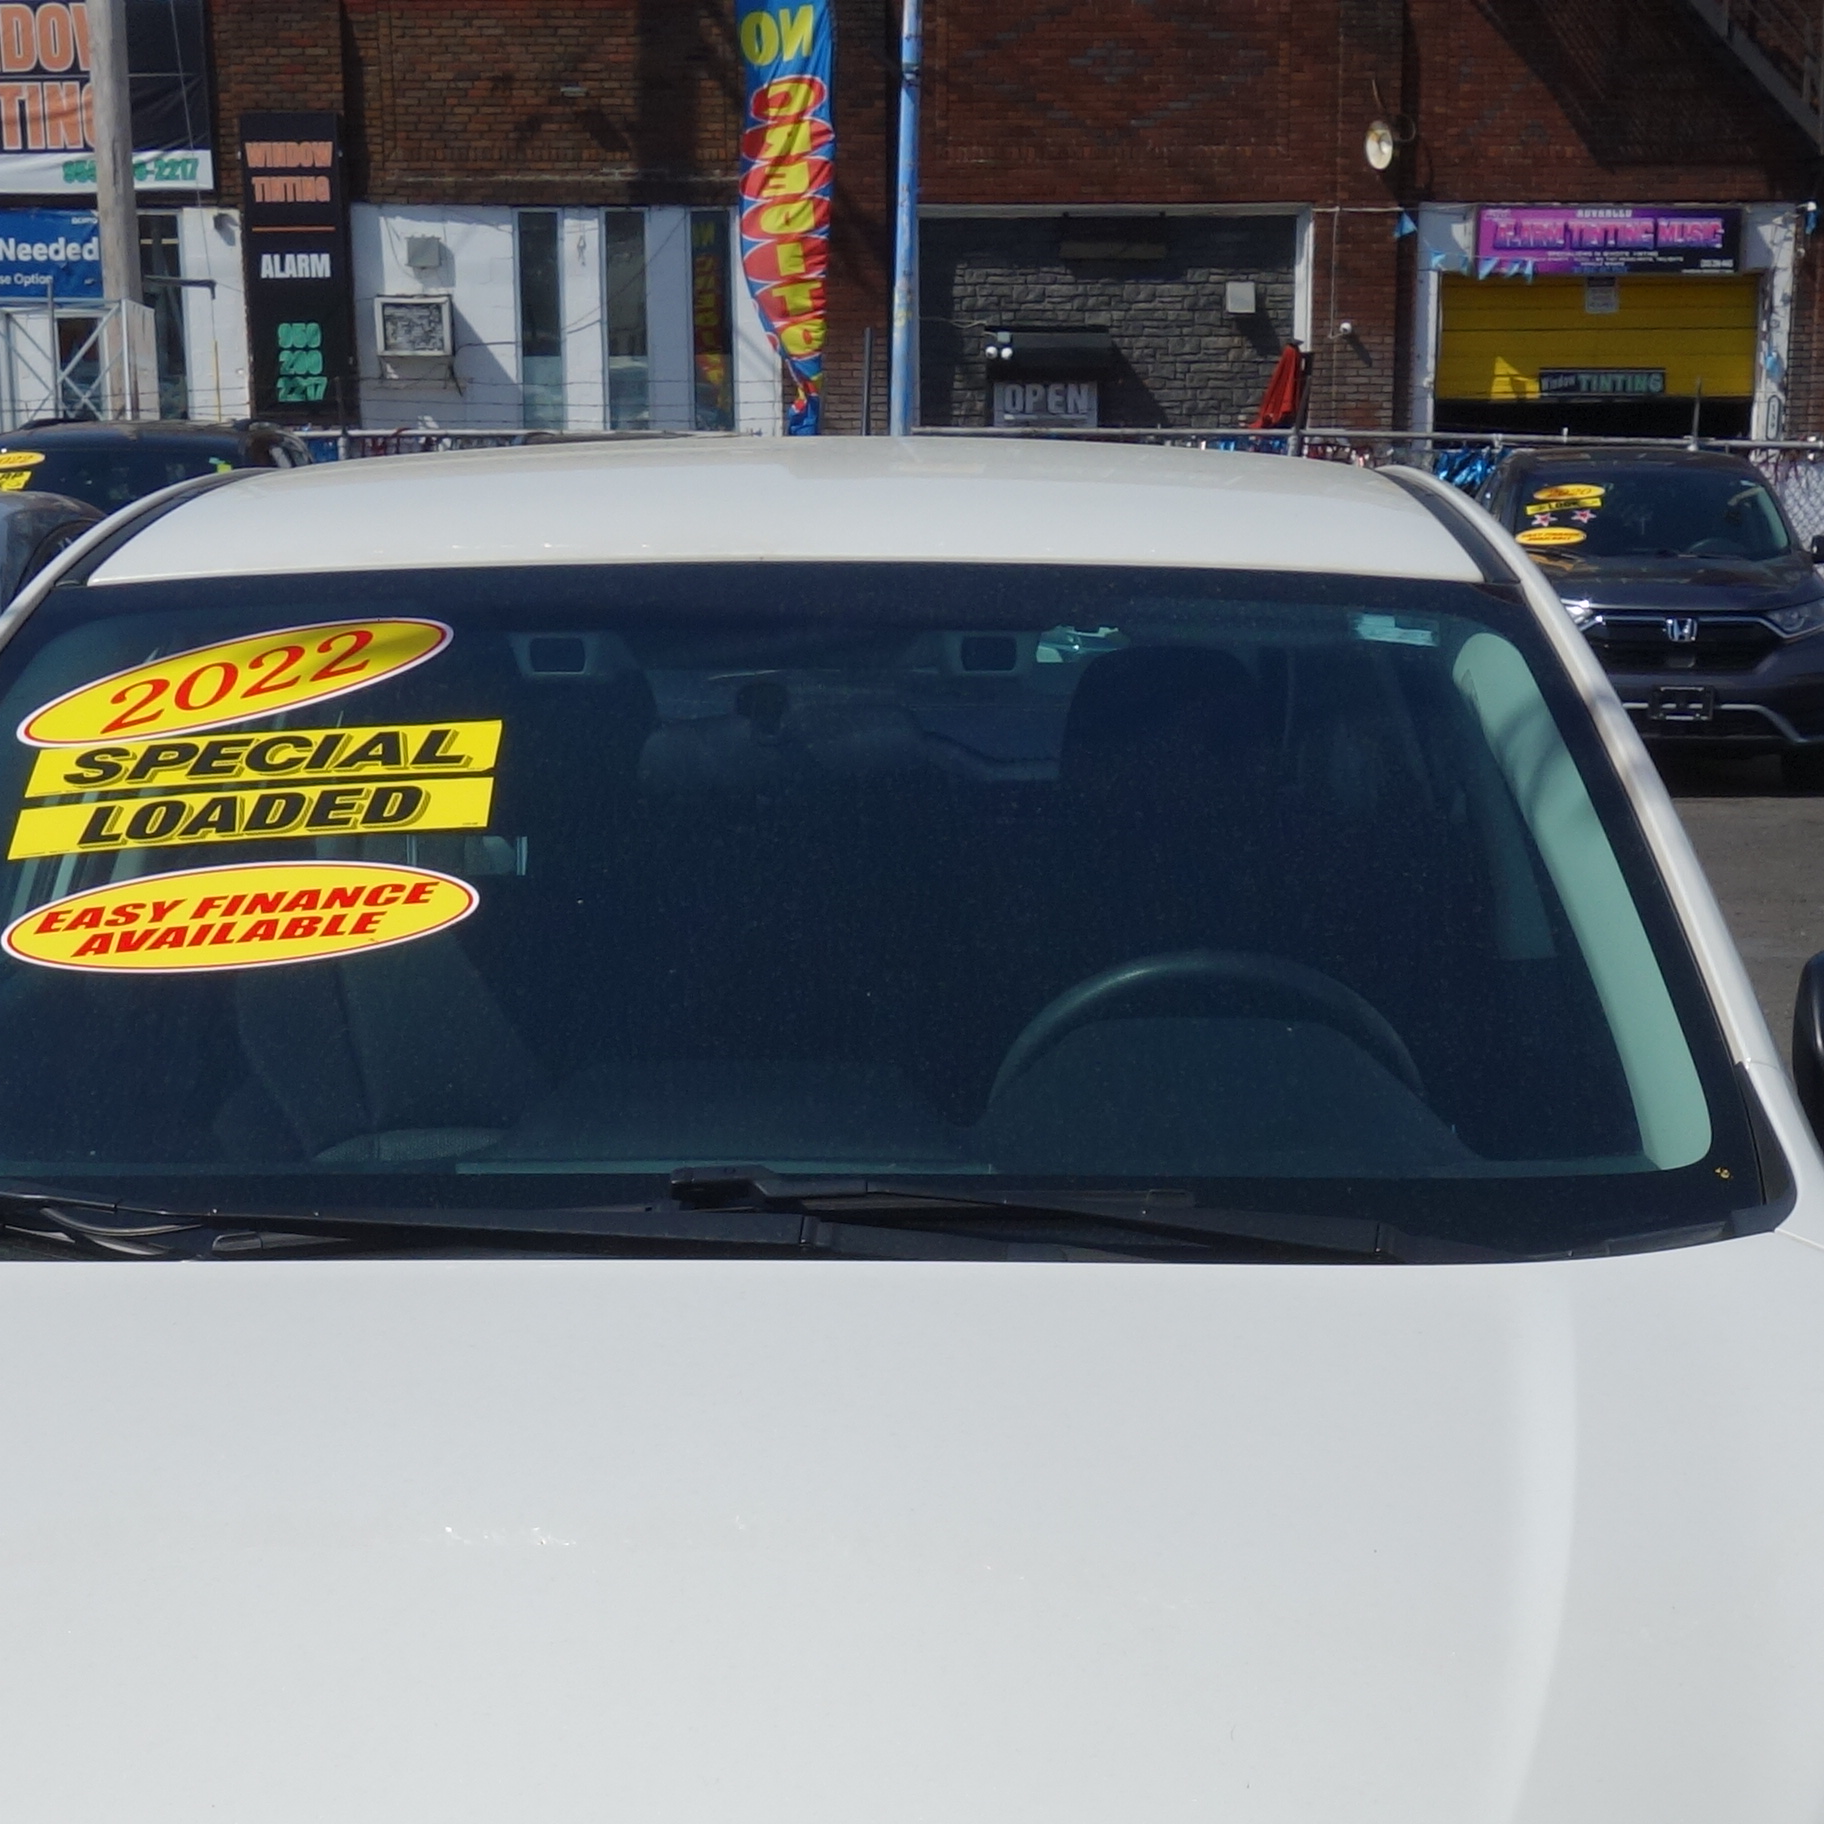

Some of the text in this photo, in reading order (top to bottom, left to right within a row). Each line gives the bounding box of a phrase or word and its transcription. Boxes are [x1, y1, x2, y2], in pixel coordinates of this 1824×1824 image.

[245, 141, 333, 168] WINDOW
[251, 175, 330, 203] TINTING
[1568, 217, 1655, 250] TINTING
[1657, 217, 1724, 249] MUSIC
[261, 253, 331, 279] ALARM
[1004, 383, 1090, 414] OPEN
[1577, 372, 1664, 393] TINTING
[100, 630, 375, 735] 2022
[63, 727, 477, 788] SPECIAL
[77, 785, 431, 849] LOADED
[35, 881, 440, 936] EASY FINANCE
[69, 910, 386, 959] AVAILABLE
